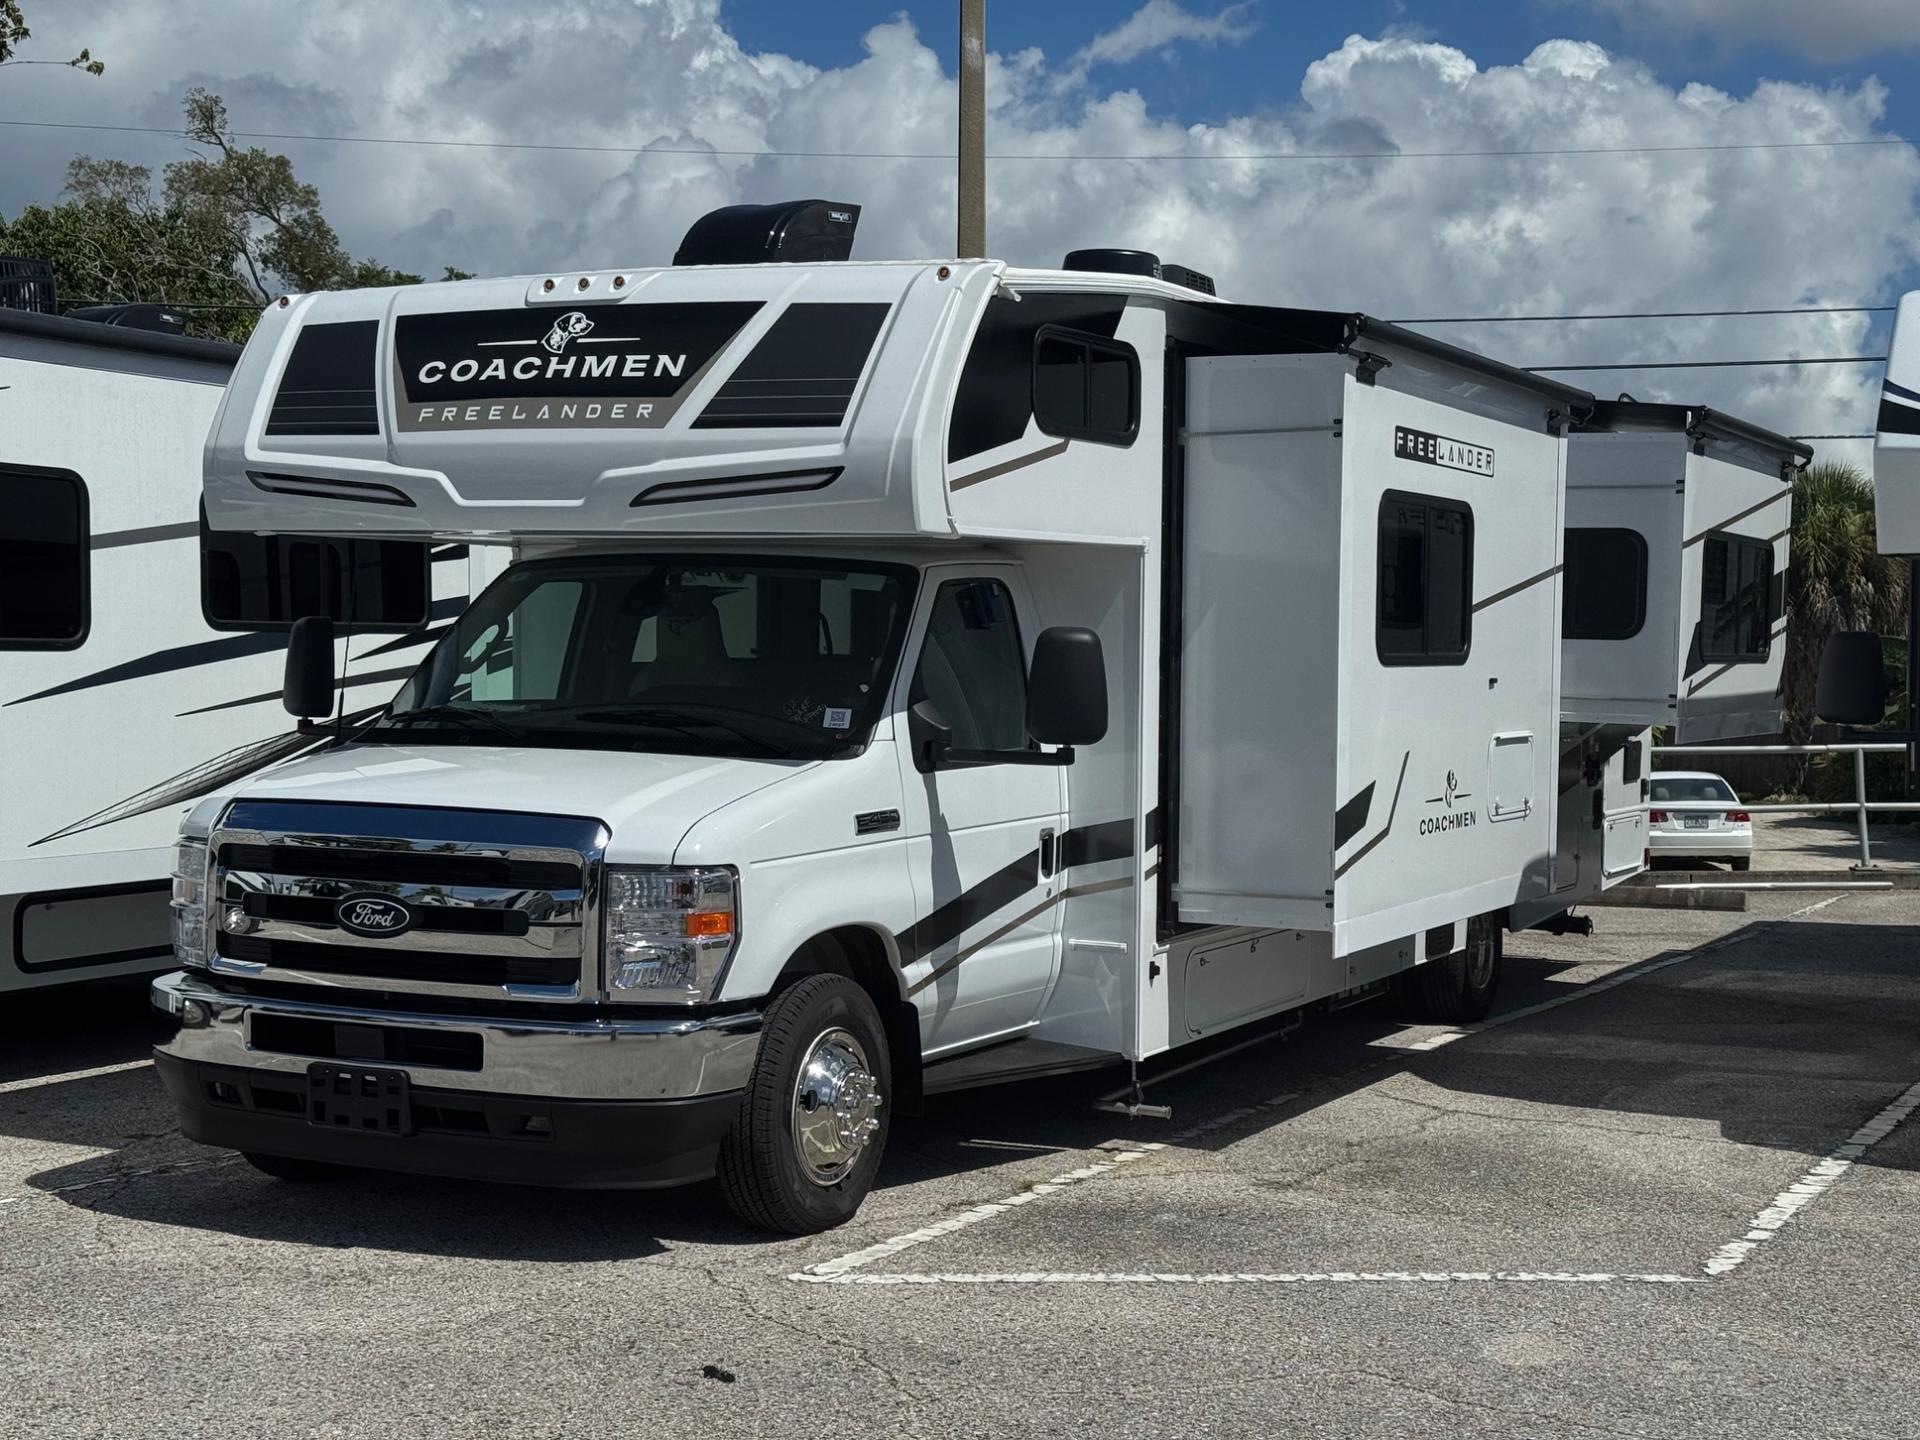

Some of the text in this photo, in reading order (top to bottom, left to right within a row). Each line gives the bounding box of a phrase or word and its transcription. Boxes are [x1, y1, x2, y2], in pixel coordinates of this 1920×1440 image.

[418, 353, 687, 384] COACHMEN
[418, 404, 654, 422] FREELANDER
[1396, 432, 1493, 471] FREELANDER
[1420, 811, 1476, 836] COACHMEN
[352, 902, 394, 927] Ford
